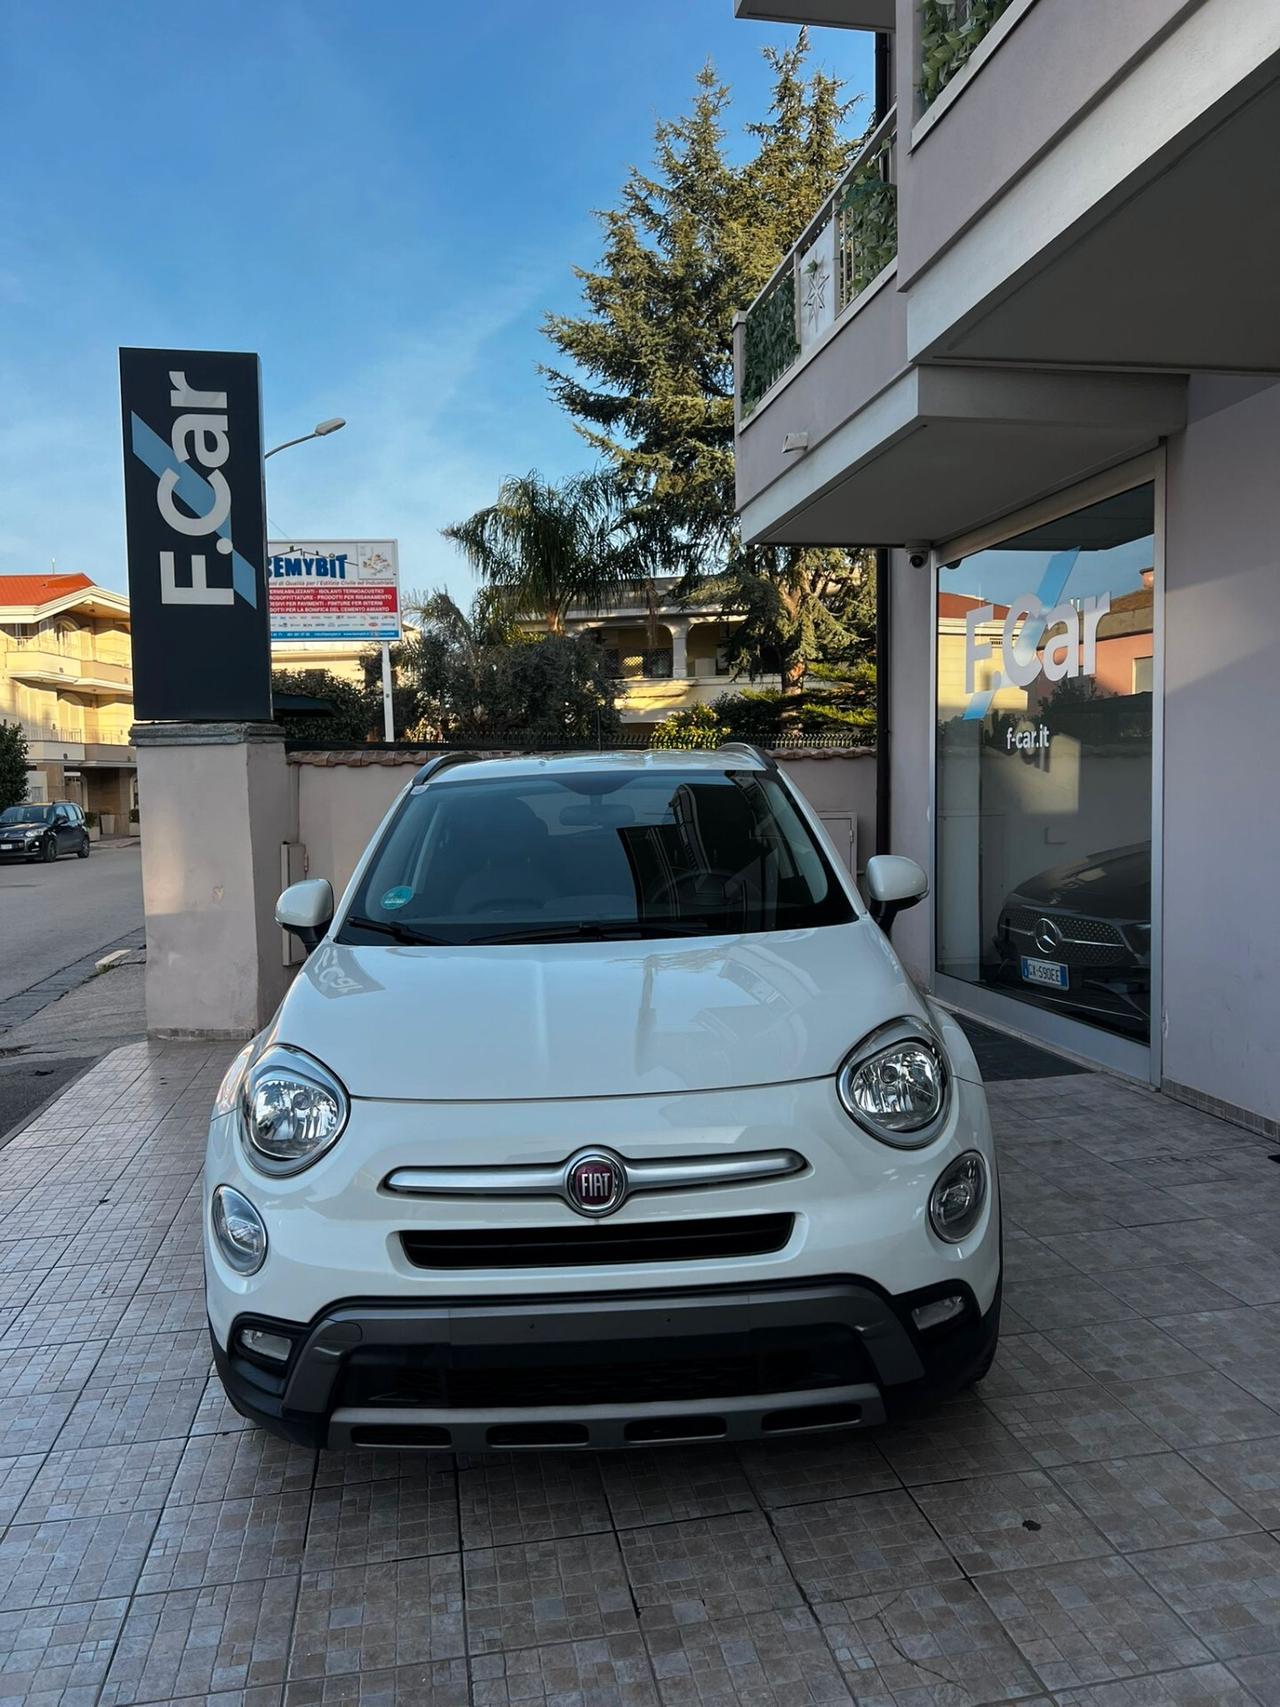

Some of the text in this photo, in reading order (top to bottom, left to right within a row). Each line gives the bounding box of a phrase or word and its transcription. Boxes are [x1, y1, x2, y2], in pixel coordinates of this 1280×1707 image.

[157, 370, 235, 605] F.Car
[1007, 724, 1050, 750] f-car.it
[581, 1173, 610, 1197] FIAT
